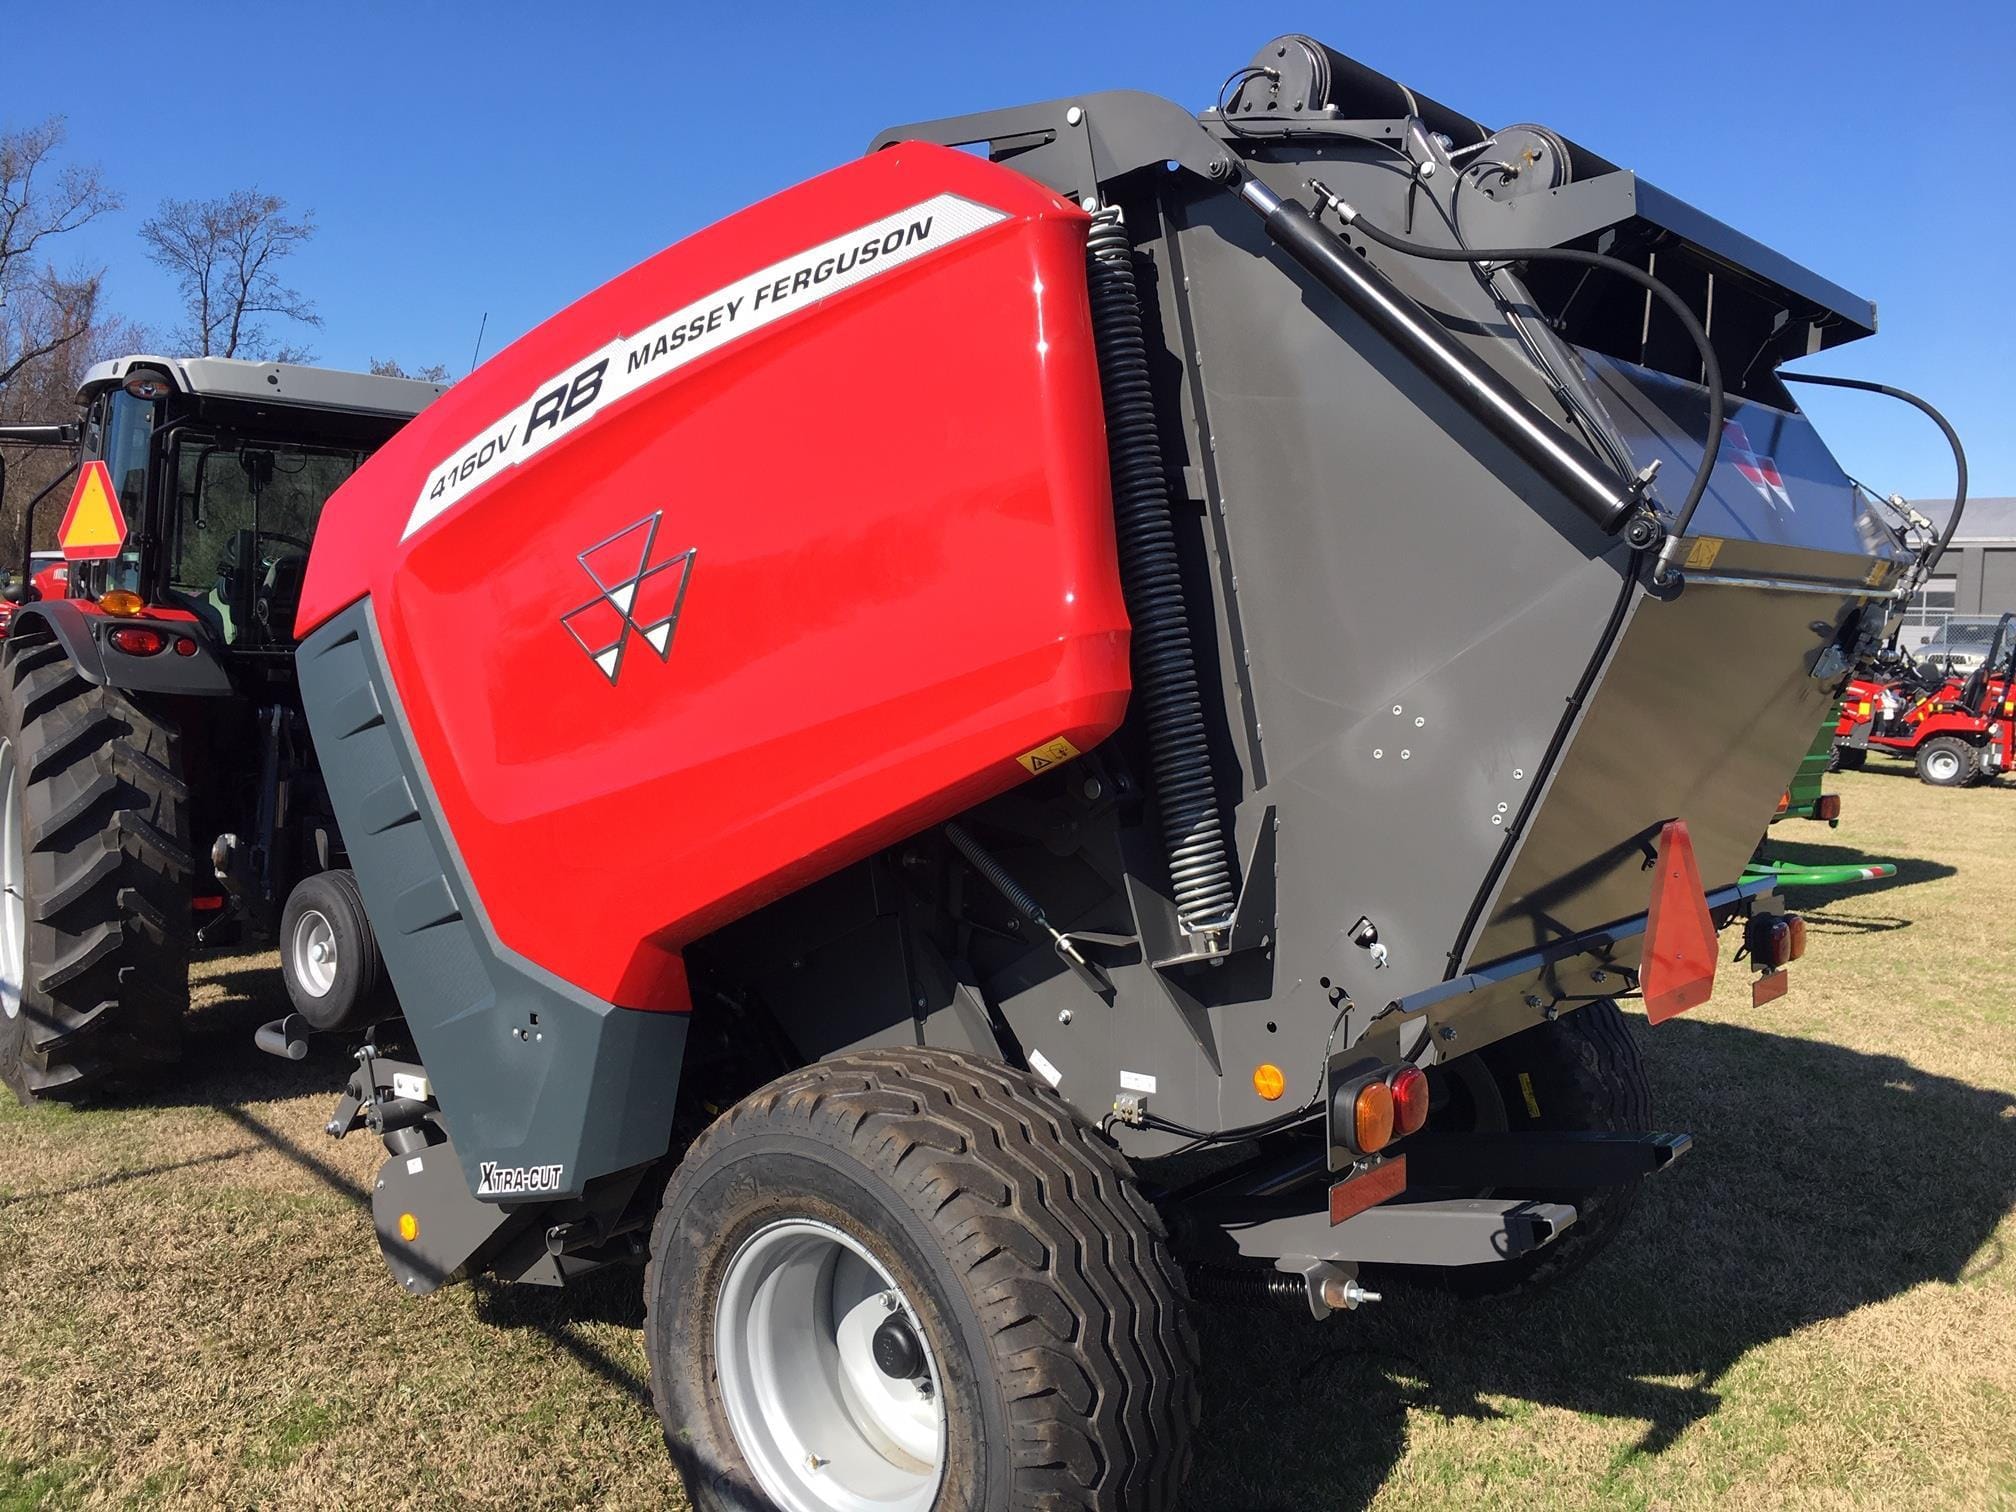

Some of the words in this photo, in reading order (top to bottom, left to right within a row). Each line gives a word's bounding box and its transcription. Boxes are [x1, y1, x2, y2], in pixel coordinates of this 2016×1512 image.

[429, 424, 517, 500] 4160V
[626, 296, 744, 374] MASSEY
[753, 216, 933, 310] FERGUSON
